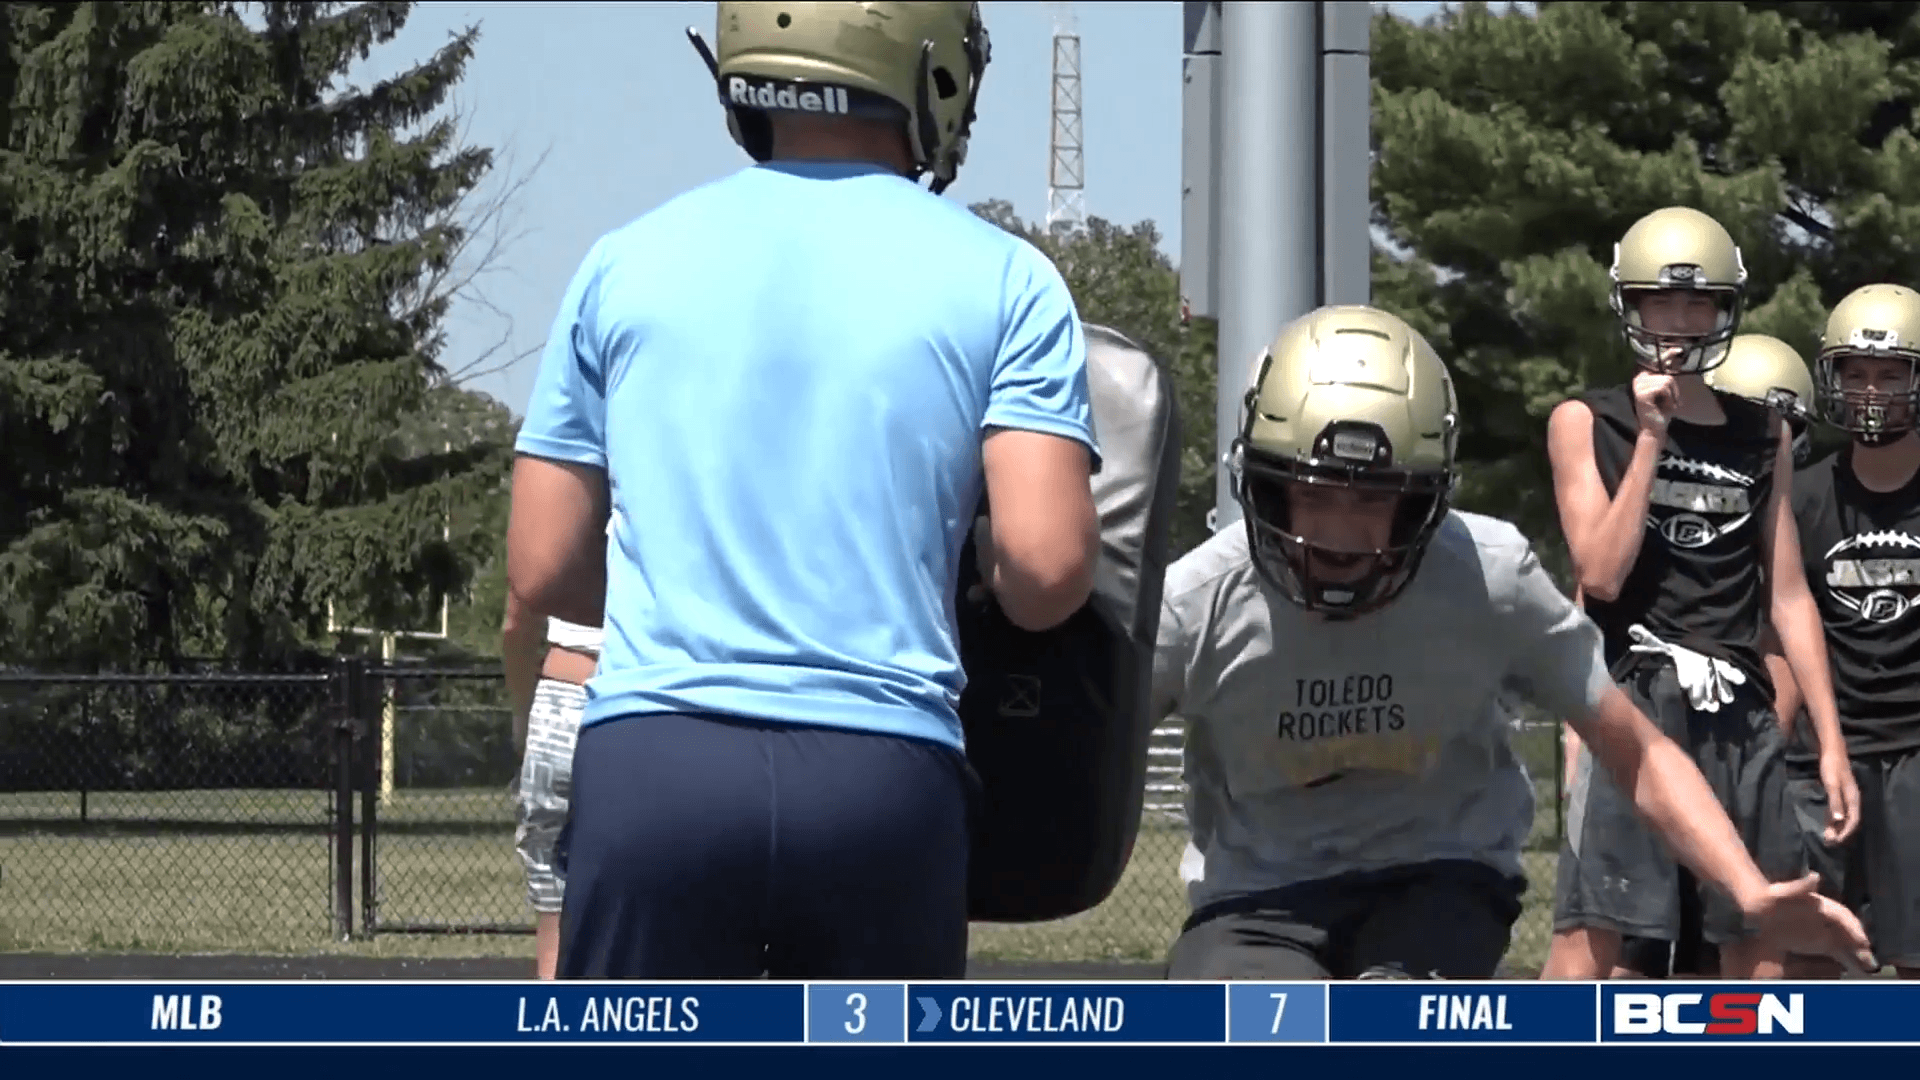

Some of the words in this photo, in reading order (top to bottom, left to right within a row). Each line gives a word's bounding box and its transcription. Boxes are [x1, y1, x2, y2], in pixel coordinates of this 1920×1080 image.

[728, 76, 849, 115] Riddell
[1296, 673, 1392, 708] TOLEDO
[1278, 703, 1405, 741] ROCKETS
